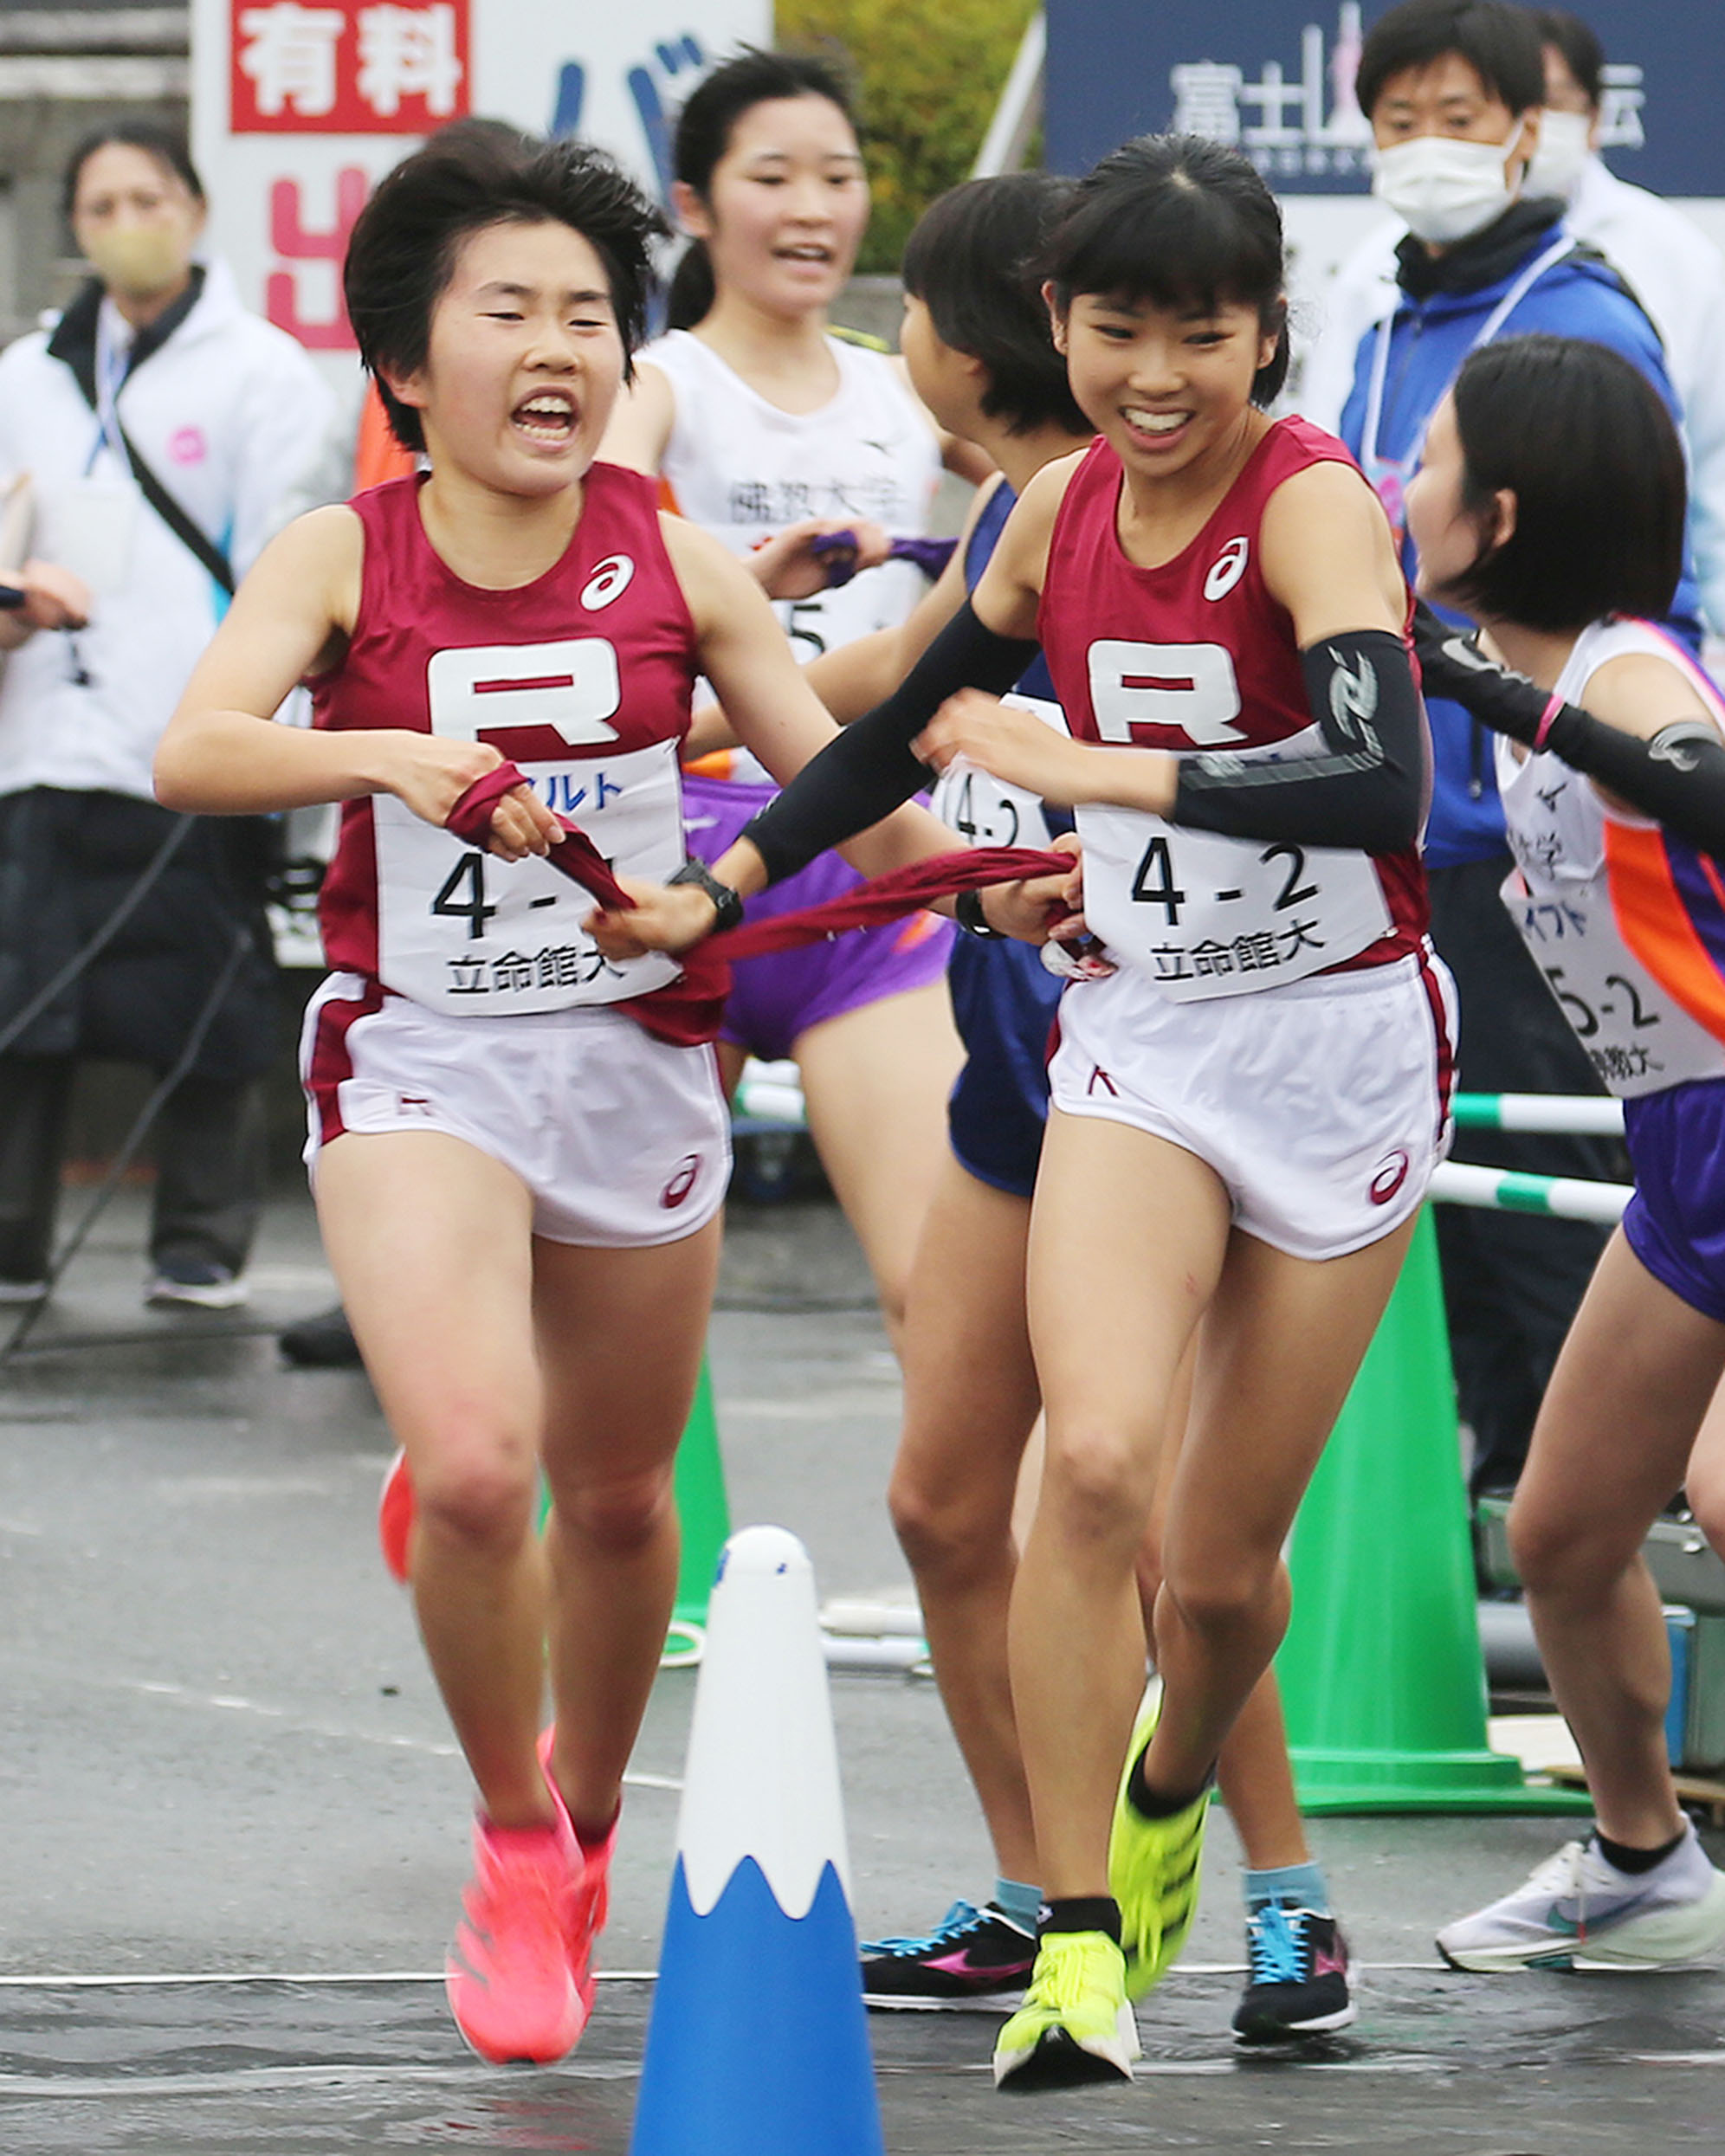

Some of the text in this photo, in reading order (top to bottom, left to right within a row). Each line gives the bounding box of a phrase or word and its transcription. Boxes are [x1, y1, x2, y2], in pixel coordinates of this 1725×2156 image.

[238, 4, 462, 116] 有料
[428, 636, 621, 746] R
[1087, 639, 1248, 746] R
[527, 771, 623, 812] ルト
[1150, 920, 1326, 981] 立命館大
